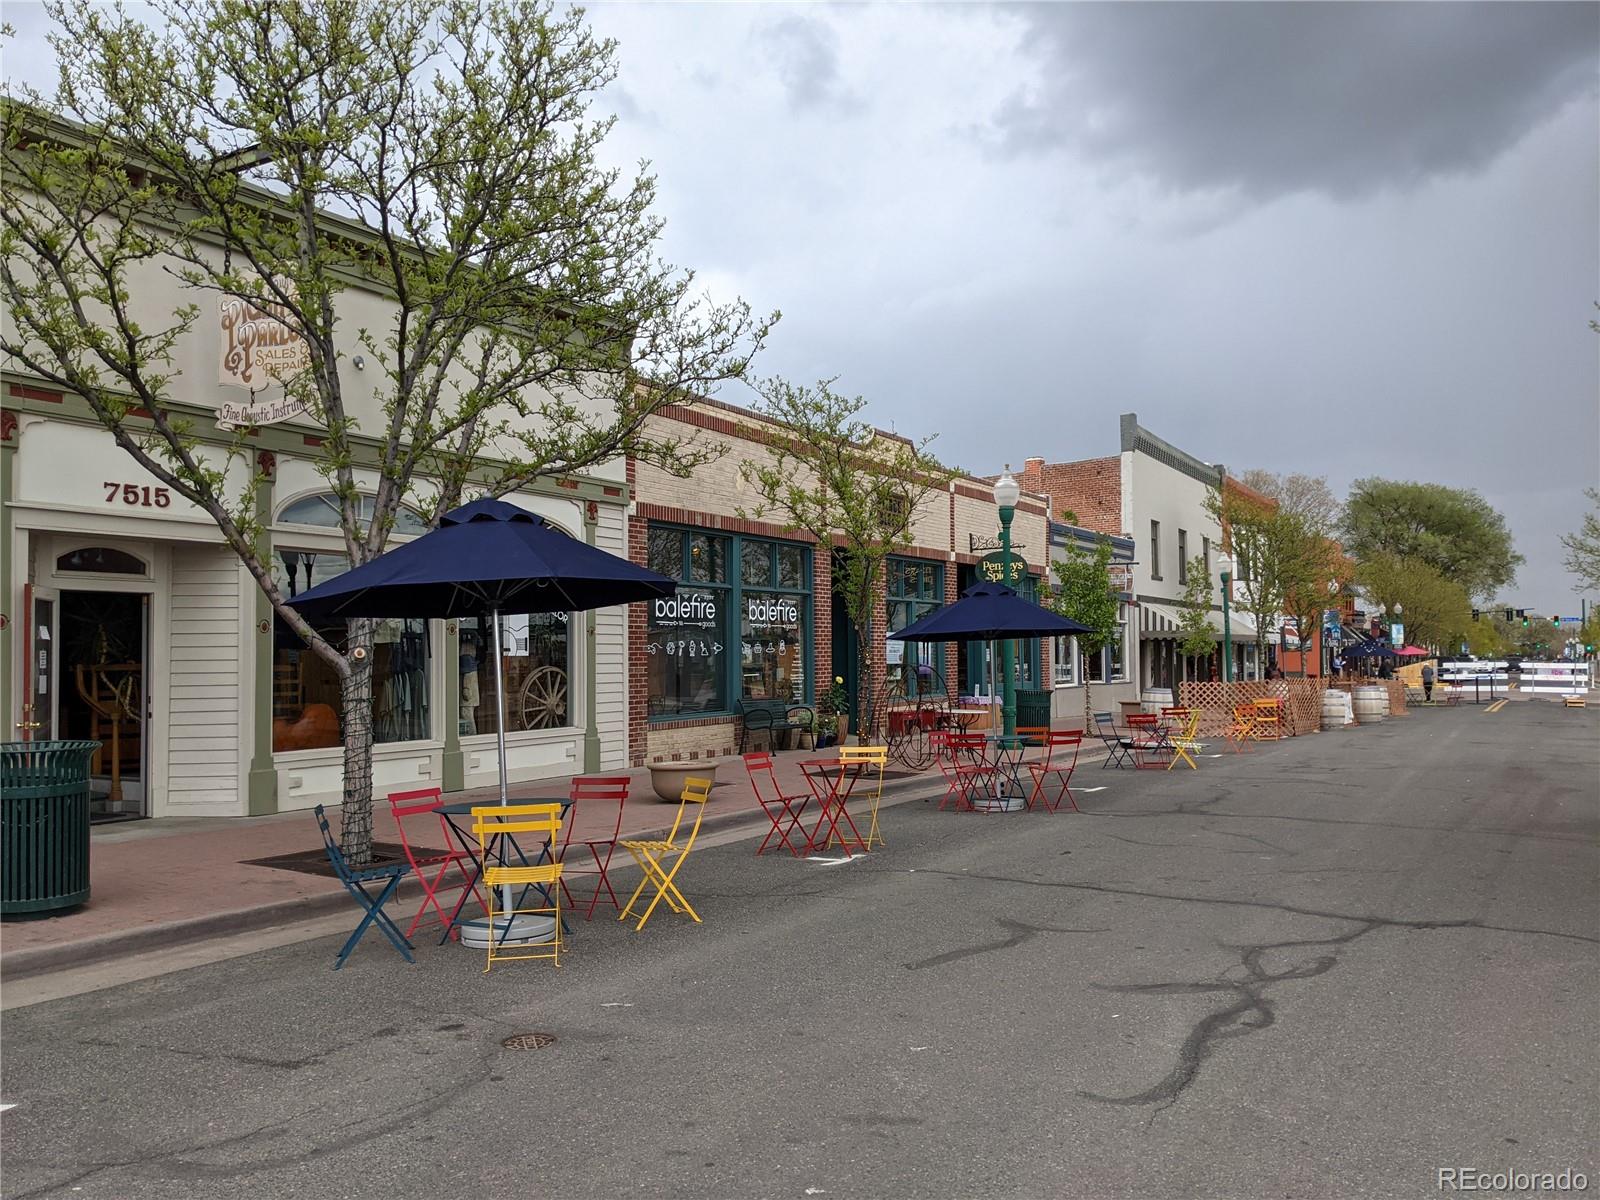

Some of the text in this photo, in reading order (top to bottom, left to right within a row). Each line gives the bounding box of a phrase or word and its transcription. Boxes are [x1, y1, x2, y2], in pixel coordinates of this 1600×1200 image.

[254, 346, 296, 367] SALES
[222, 403, 240, 422] Fine
[103, 481, 171, 508] 7515
[655, 593, 716, 619] balefire
[748, 598, 797, 621] balefire
